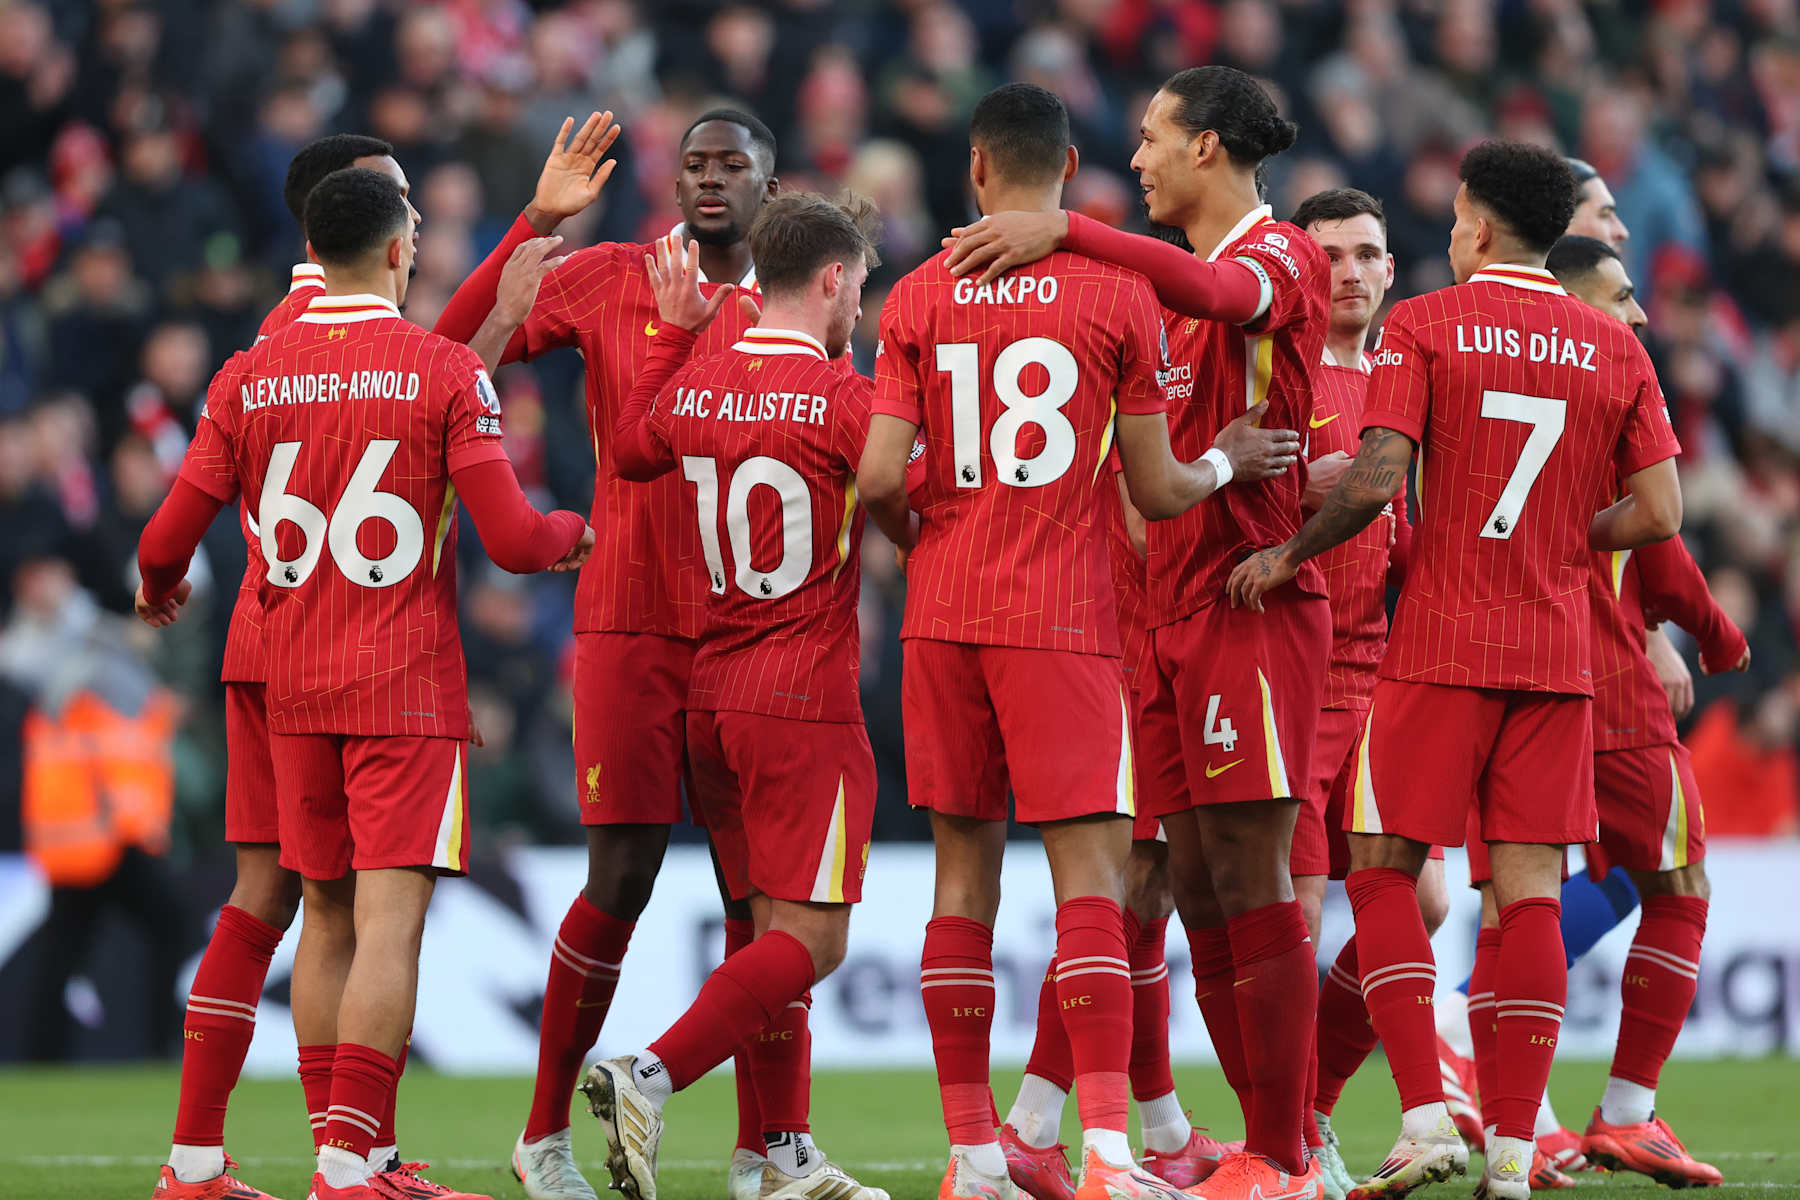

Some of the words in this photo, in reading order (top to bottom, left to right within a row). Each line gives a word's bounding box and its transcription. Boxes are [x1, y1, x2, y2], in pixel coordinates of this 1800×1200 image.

[953, 275, 1058, 305] GAKPO
[1455, 324, 1521, 358] LUIS
[1529, 327, 1598, 372] DÍAZ
[240, 370, 420, 414] ALEXANDER-ARNOLD
[716, 391, 828, 426] ALLISTER
[935, 336, 1080, 488] 18
[1478, 389, 1568, 540] 7
[258, 439, 425, 588] 66
[681, 455, 813, 600] 10
[1203, 693, 1238, 752] 4
[952, 1007, 986, 1017] LFC
[1062, 995, 1092, 1010] LFC
[760, 1030, 793, 1042] LFC
[1530, 1034, 1556, 1048] LFC
